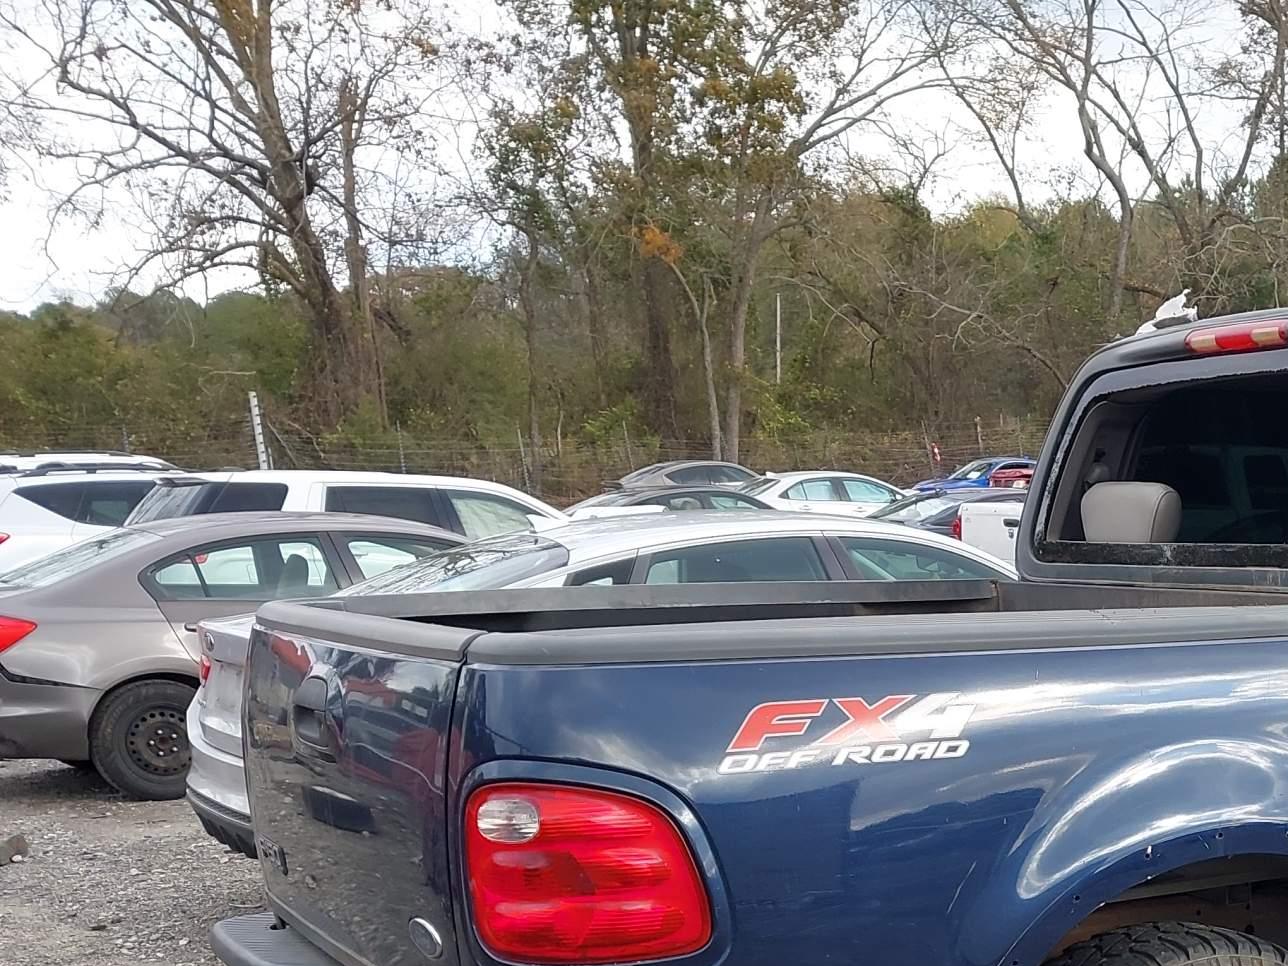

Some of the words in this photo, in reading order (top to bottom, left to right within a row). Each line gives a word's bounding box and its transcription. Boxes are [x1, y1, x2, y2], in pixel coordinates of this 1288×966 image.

[725, 691, 977, 753] FX4
[716, 748, 824, 775] OFF
[831, 739, 970, 766] ROAD
